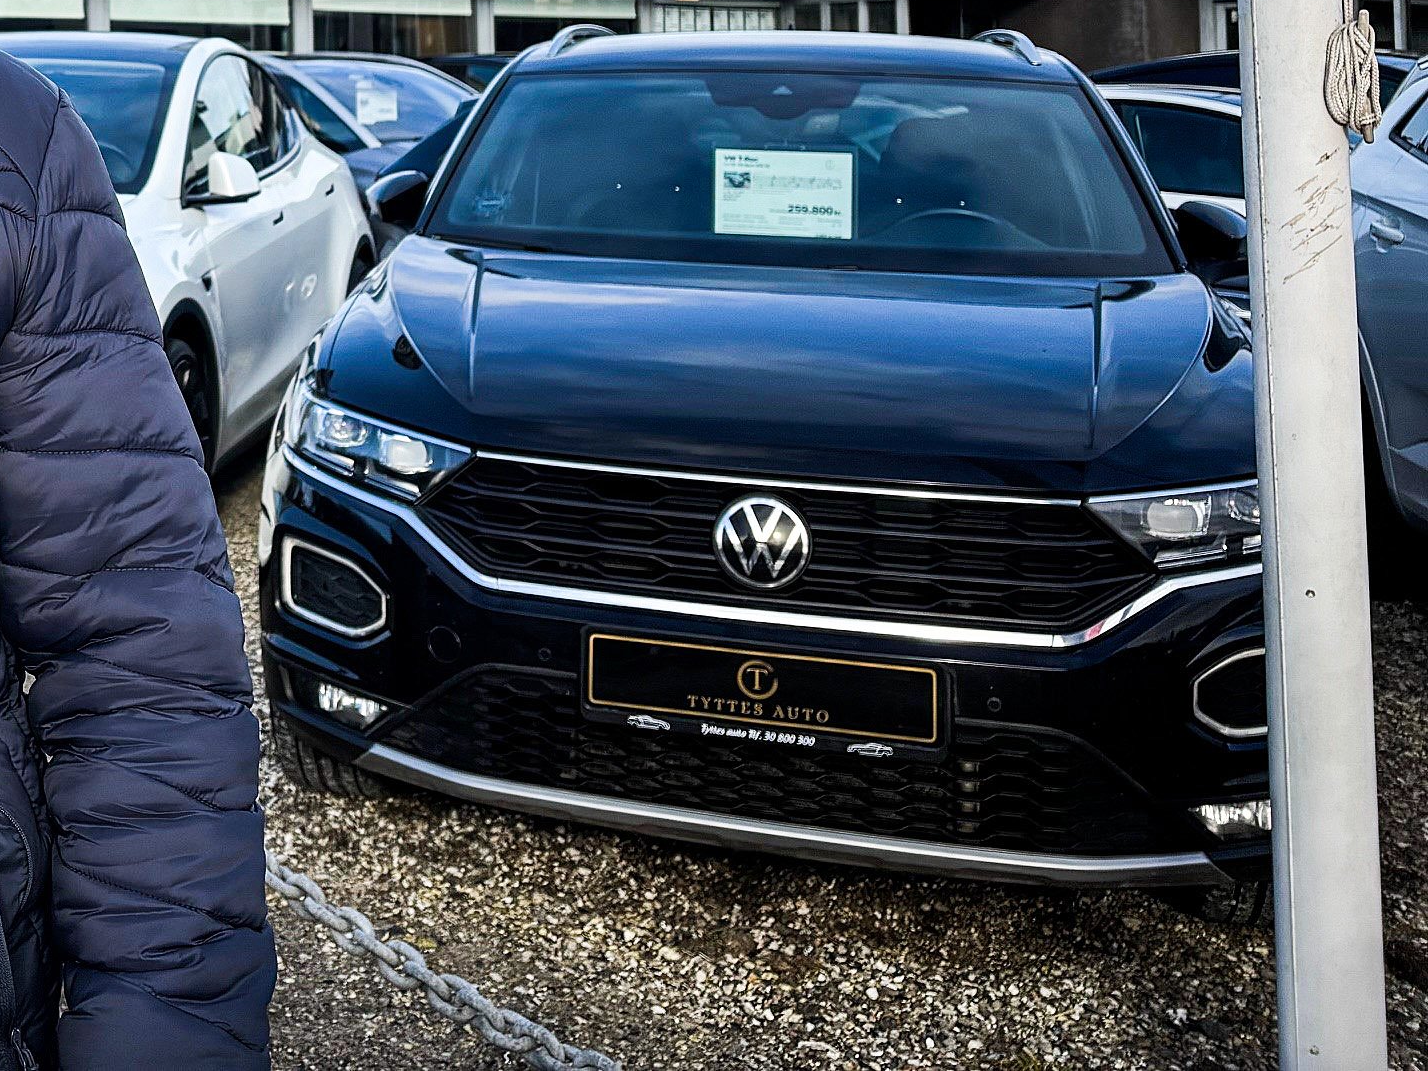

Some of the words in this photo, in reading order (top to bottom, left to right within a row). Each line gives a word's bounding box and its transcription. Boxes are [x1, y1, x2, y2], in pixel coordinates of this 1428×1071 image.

[687, 695, 764, 717] TYTTES
[772, 704, 830, 724] AUTO
[726, 728, 747, 739] auto
[763, 730, 777, 742] 30
[777, 733, 796, 745] 800
[797, 734, 816, 747] 300
